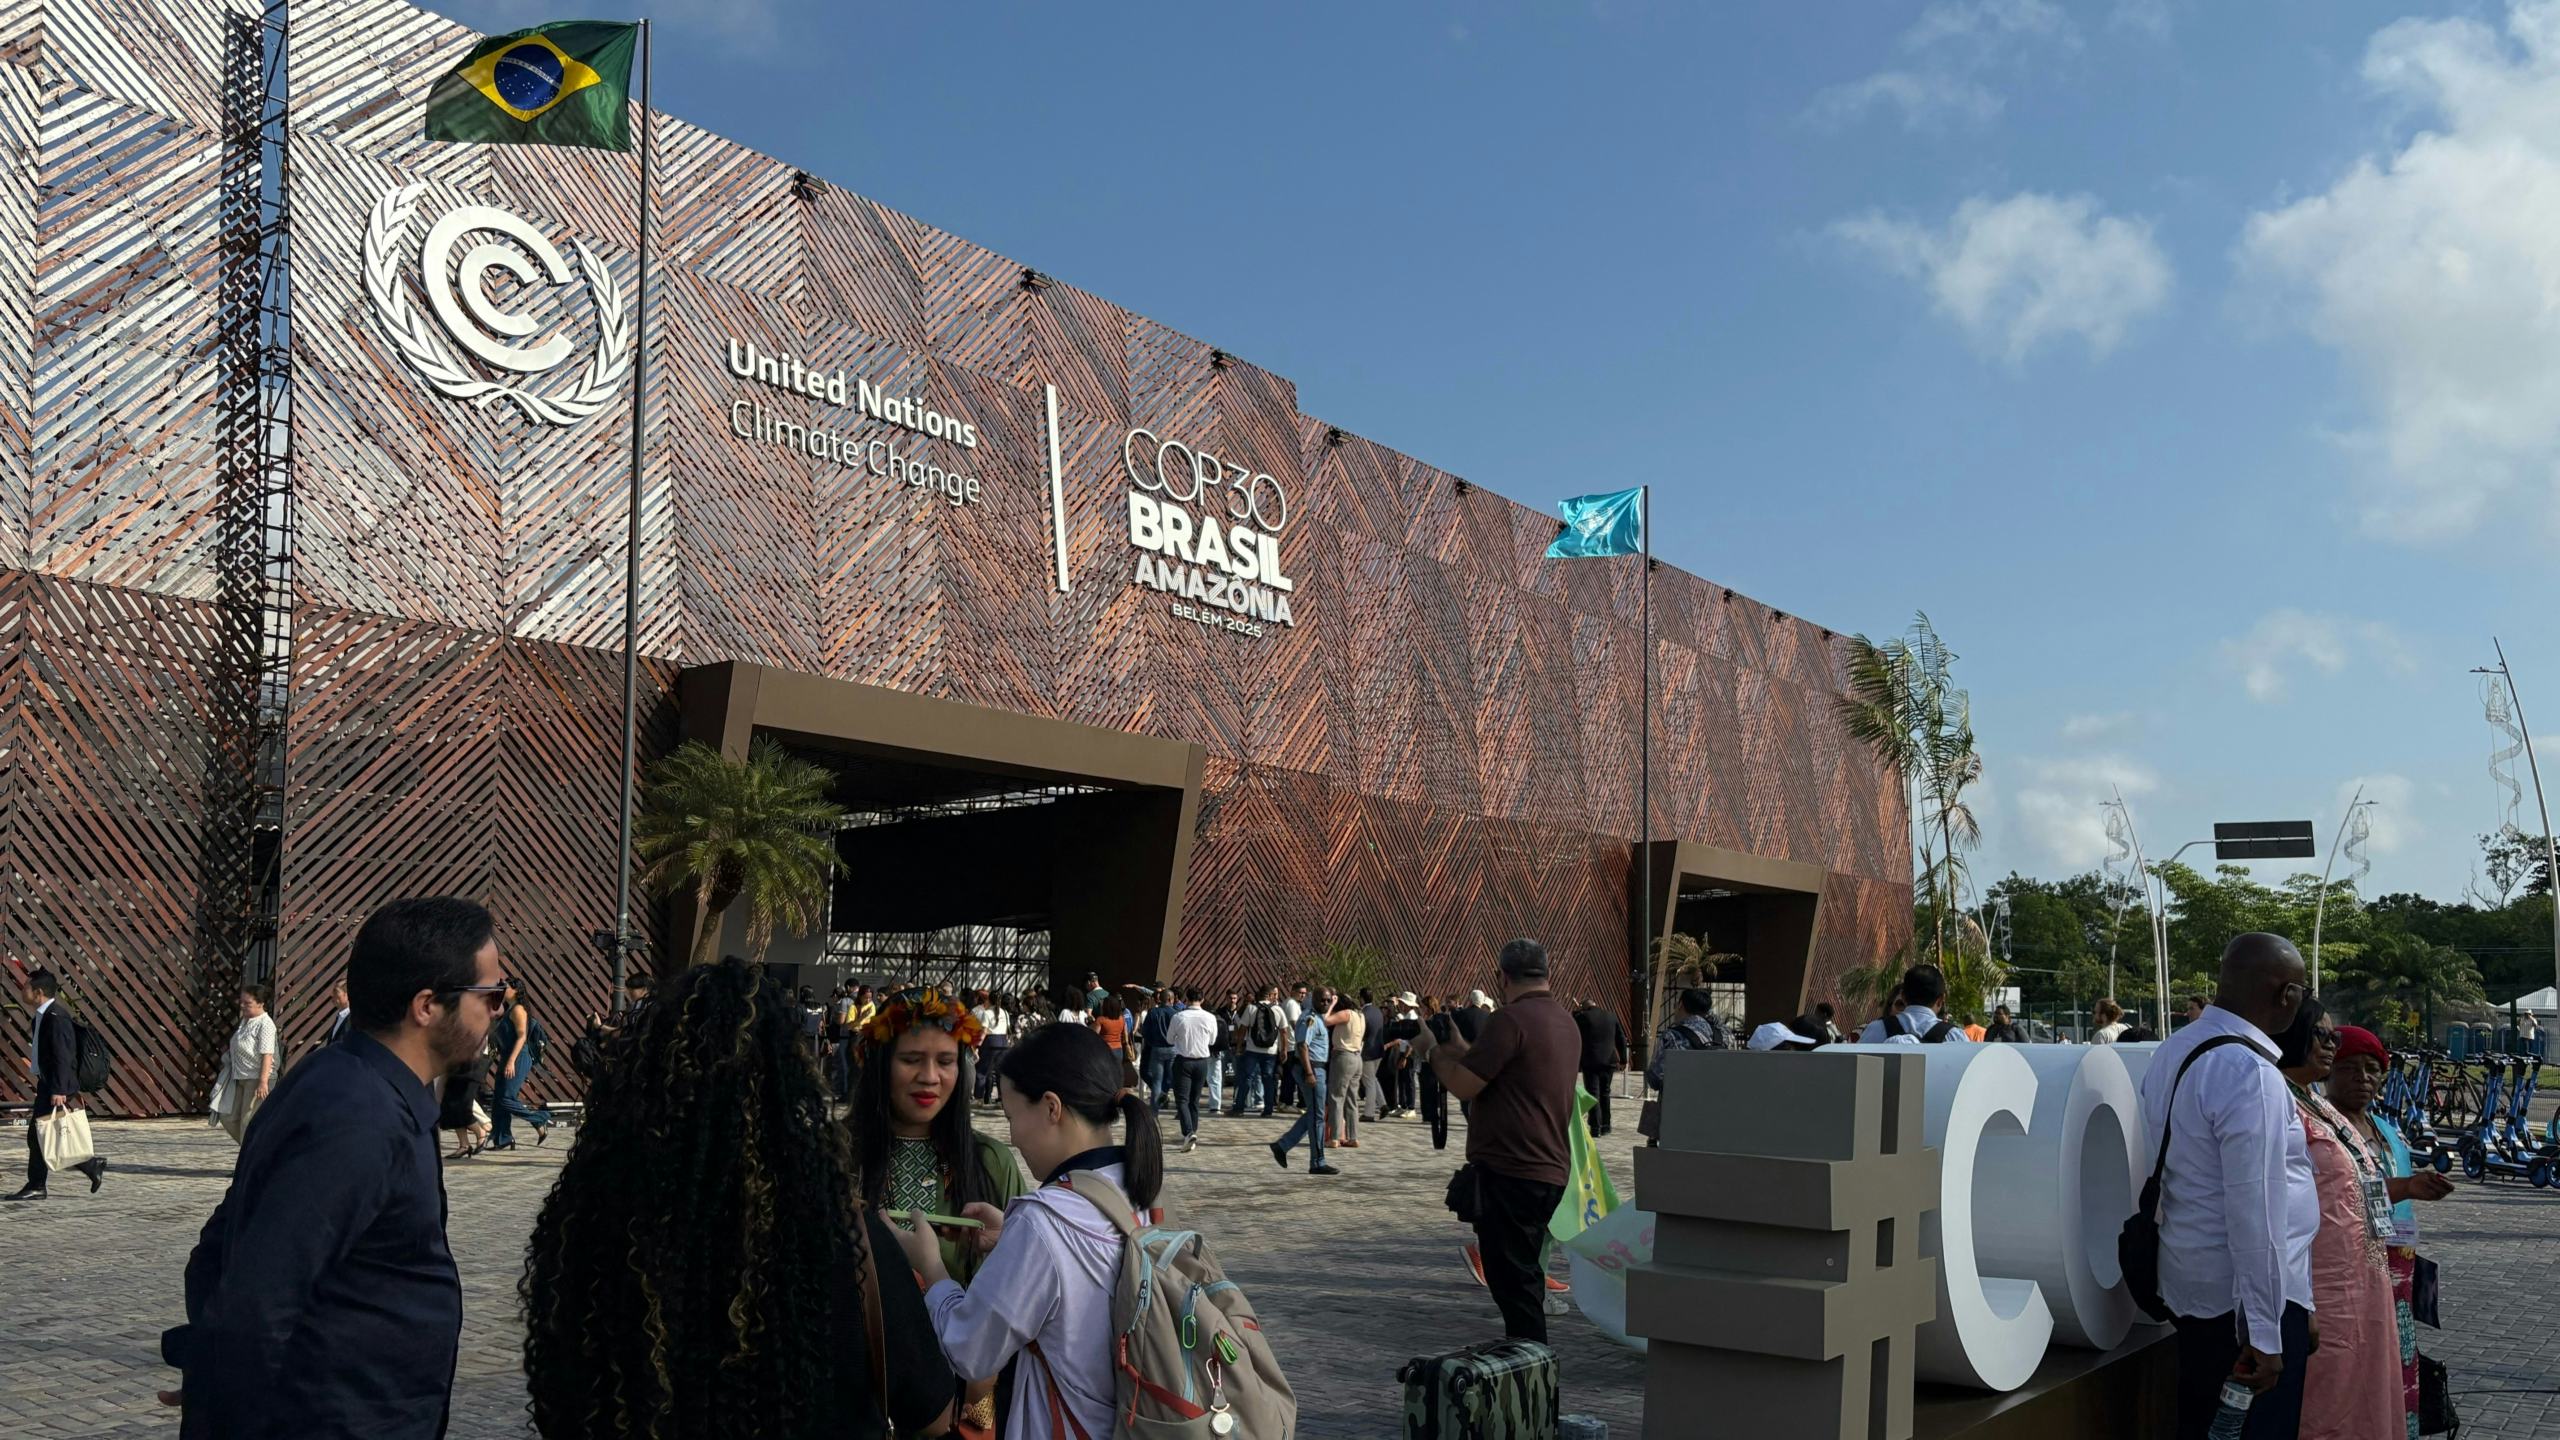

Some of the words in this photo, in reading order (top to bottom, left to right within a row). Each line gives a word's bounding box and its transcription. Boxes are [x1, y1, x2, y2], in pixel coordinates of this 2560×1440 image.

[729, 337, 846, 405] United
[858, 378, 977, 448] Nations
[732, 400, 860, 467] Climate
[868, 440, 980, 506] Change
[1125, 428, 1286, 532] COP30
[1129, 490, 1293, 592] BRASIL
[1135, 553, 1295, 627] AMAZÔNIA
[1173, 603, 1223, 628] BELÉM
[1227, 617, 1263, 638] 2025
